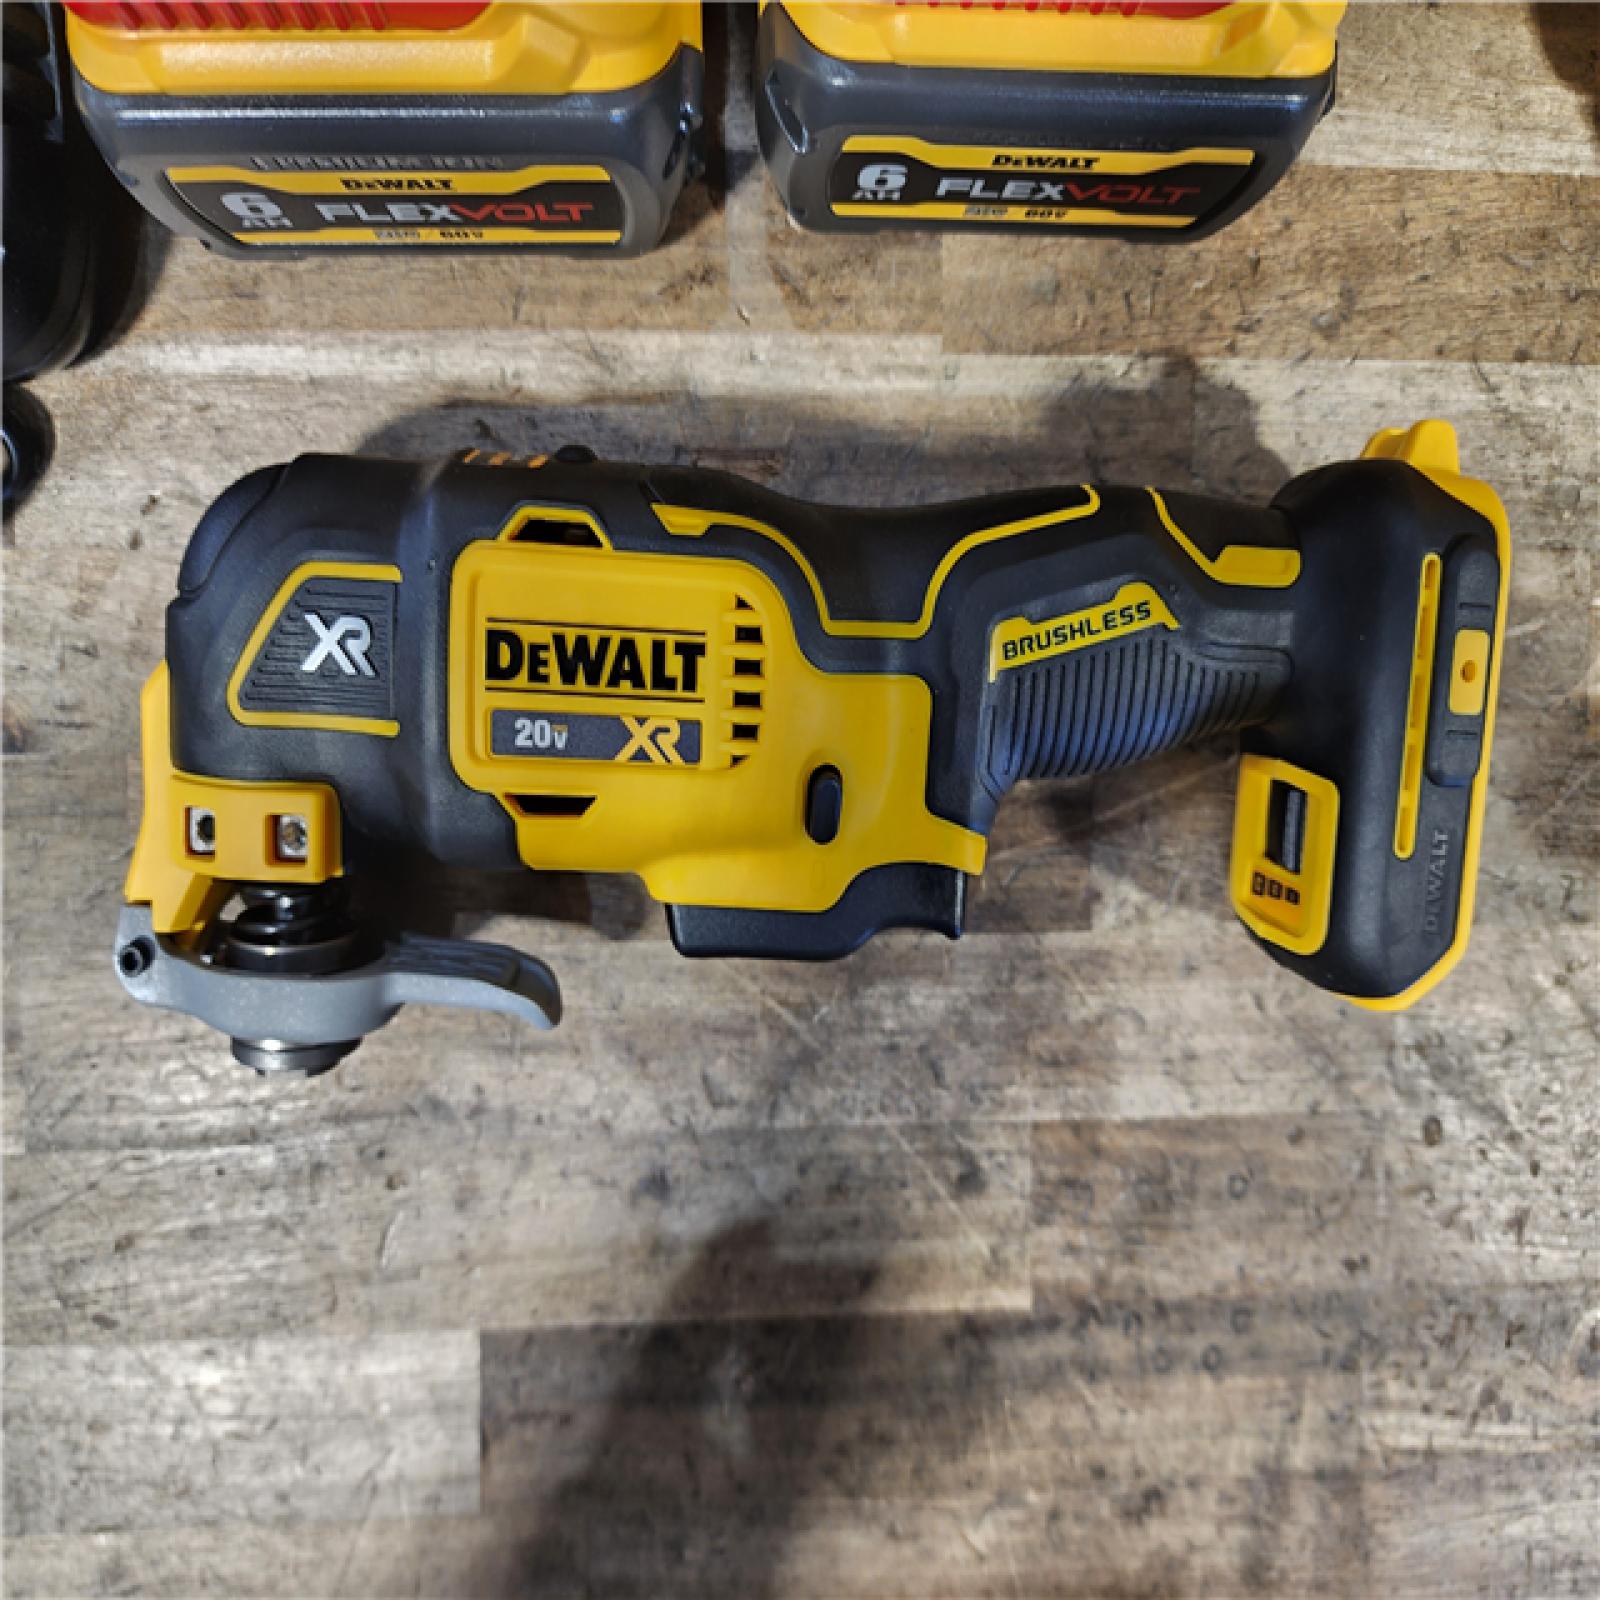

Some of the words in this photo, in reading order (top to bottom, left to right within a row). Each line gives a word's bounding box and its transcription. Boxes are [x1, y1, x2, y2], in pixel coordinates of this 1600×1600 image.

[857, 163, 908, 189] 6
[991, 154, 1101, 169] DEWALT
[221, 192, 285, 216] 6
[935, 177, 1201, 206] FLEXVOLT
[315, 202, 593, 223] FLEXVOLT
[301, 613, 377, 677] XR
[1002, 600, 1151, 661] BRUSHLESS
[484, 629, 706, 692] DEWALT
[614, 716, 687, 764] XR
